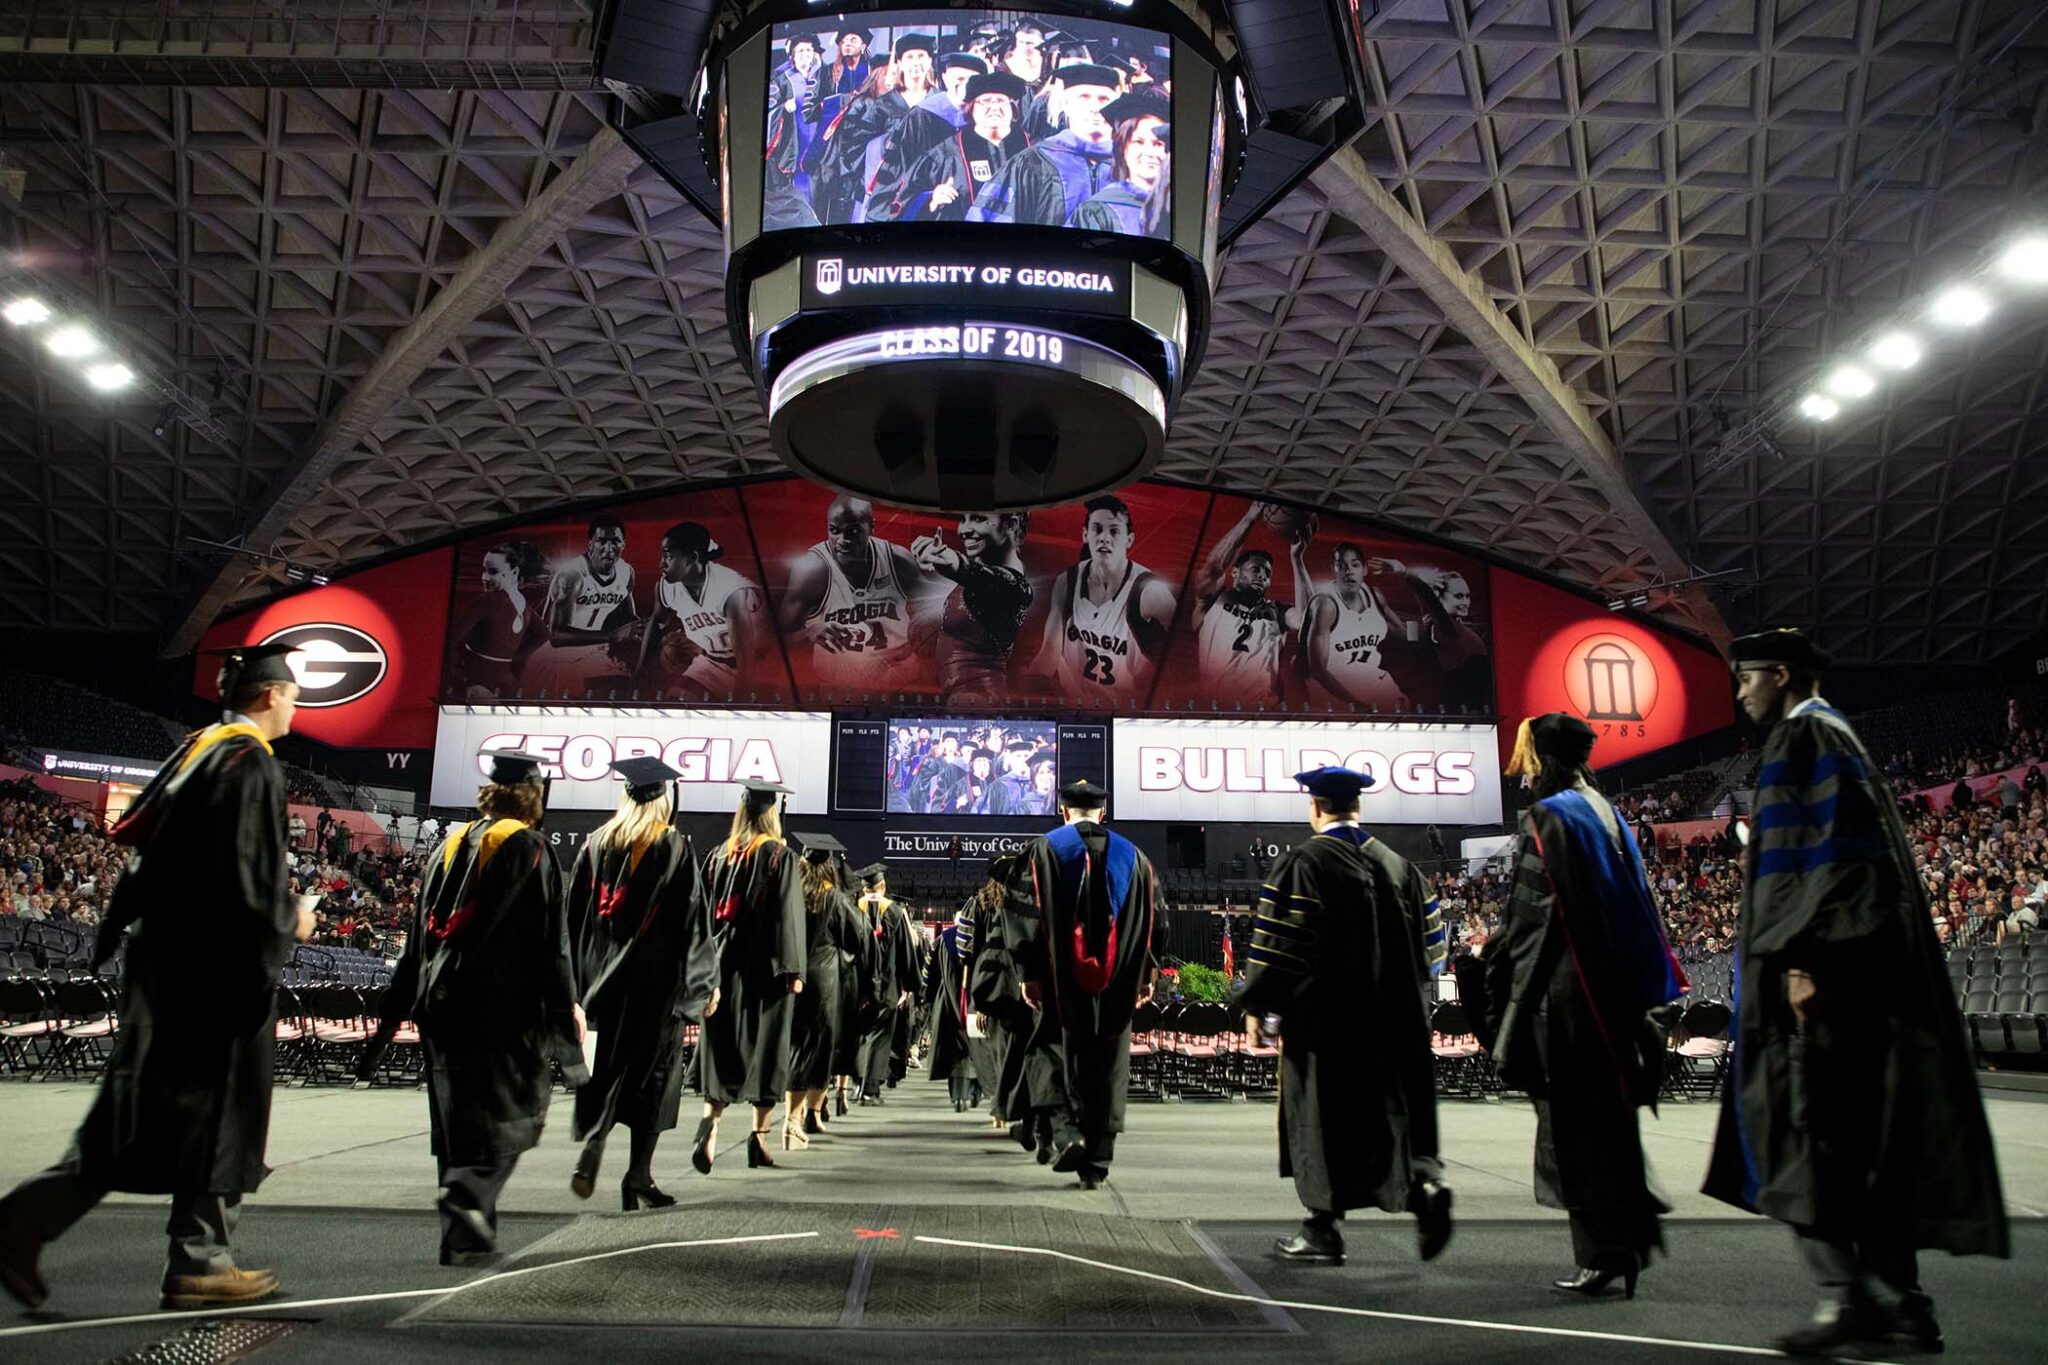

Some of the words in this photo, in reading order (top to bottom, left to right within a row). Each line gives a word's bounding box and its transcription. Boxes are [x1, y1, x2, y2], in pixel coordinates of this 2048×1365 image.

[847, 265, 976, 284] UNIVERSITY
[981, 266, 1012, 284] OF
[1016, 268, 1114, 292] GEORGIA
[880, 326, 960, 357] CLASS
[963, 327, 996, 353] OF
[1004, 330, 1063, 364] 2019
[1232, 623, 1250, 652] 2
[1083, 648, 1116, 686] 23
[1588, 723, 1645, 738] 785
[386, 752, 411, 769] YY
[885, 836, 913, 851] The
[982, 838, 998, 852] of
